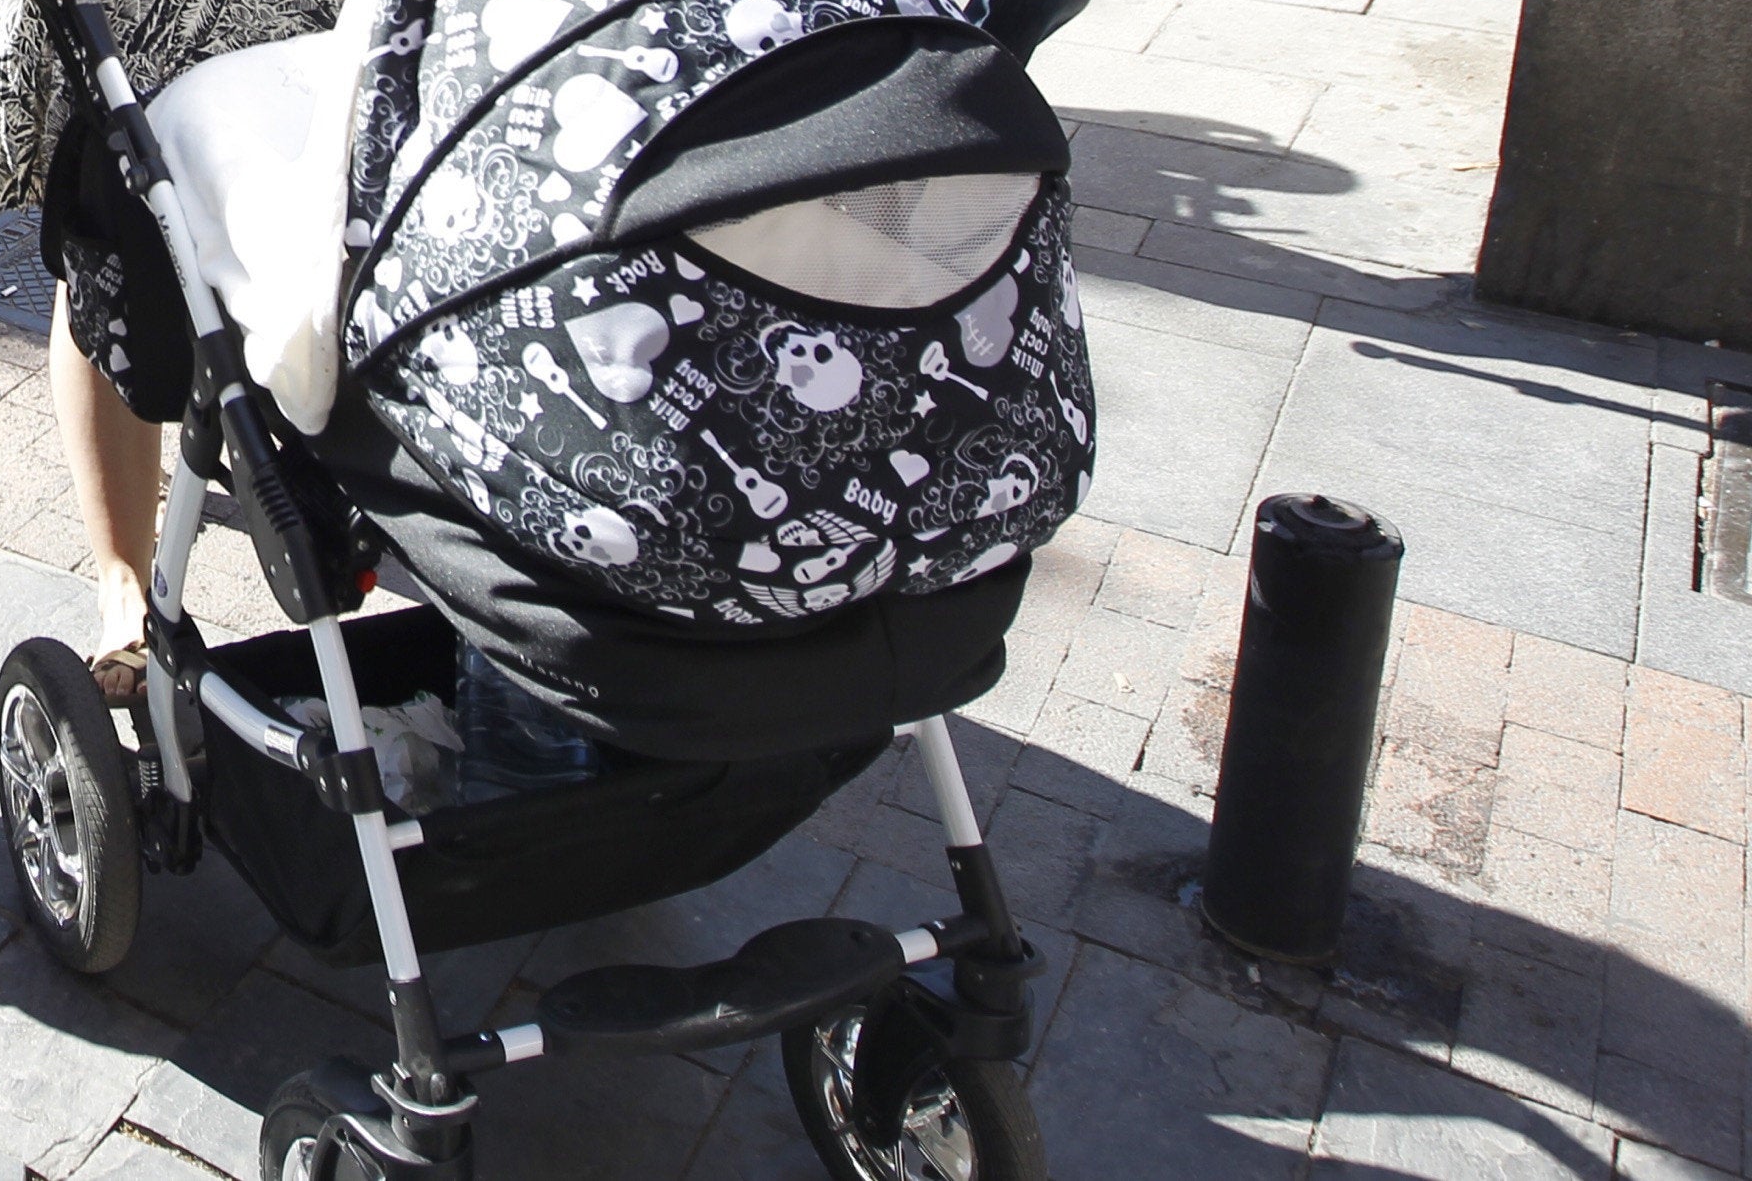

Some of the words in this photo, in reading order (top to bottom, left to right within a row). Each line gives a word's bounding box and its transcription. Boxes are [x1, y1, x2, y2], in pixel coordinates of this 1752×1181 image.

[1019, 328, 1049, 356] rock
[675, 358, 717, 399] baby
[1011, 345, 1045, 379] milk
[648, 392, 691, 432] milk
[663, 376, 704, 411] rock
[844, 477, 899, 526] Baby
